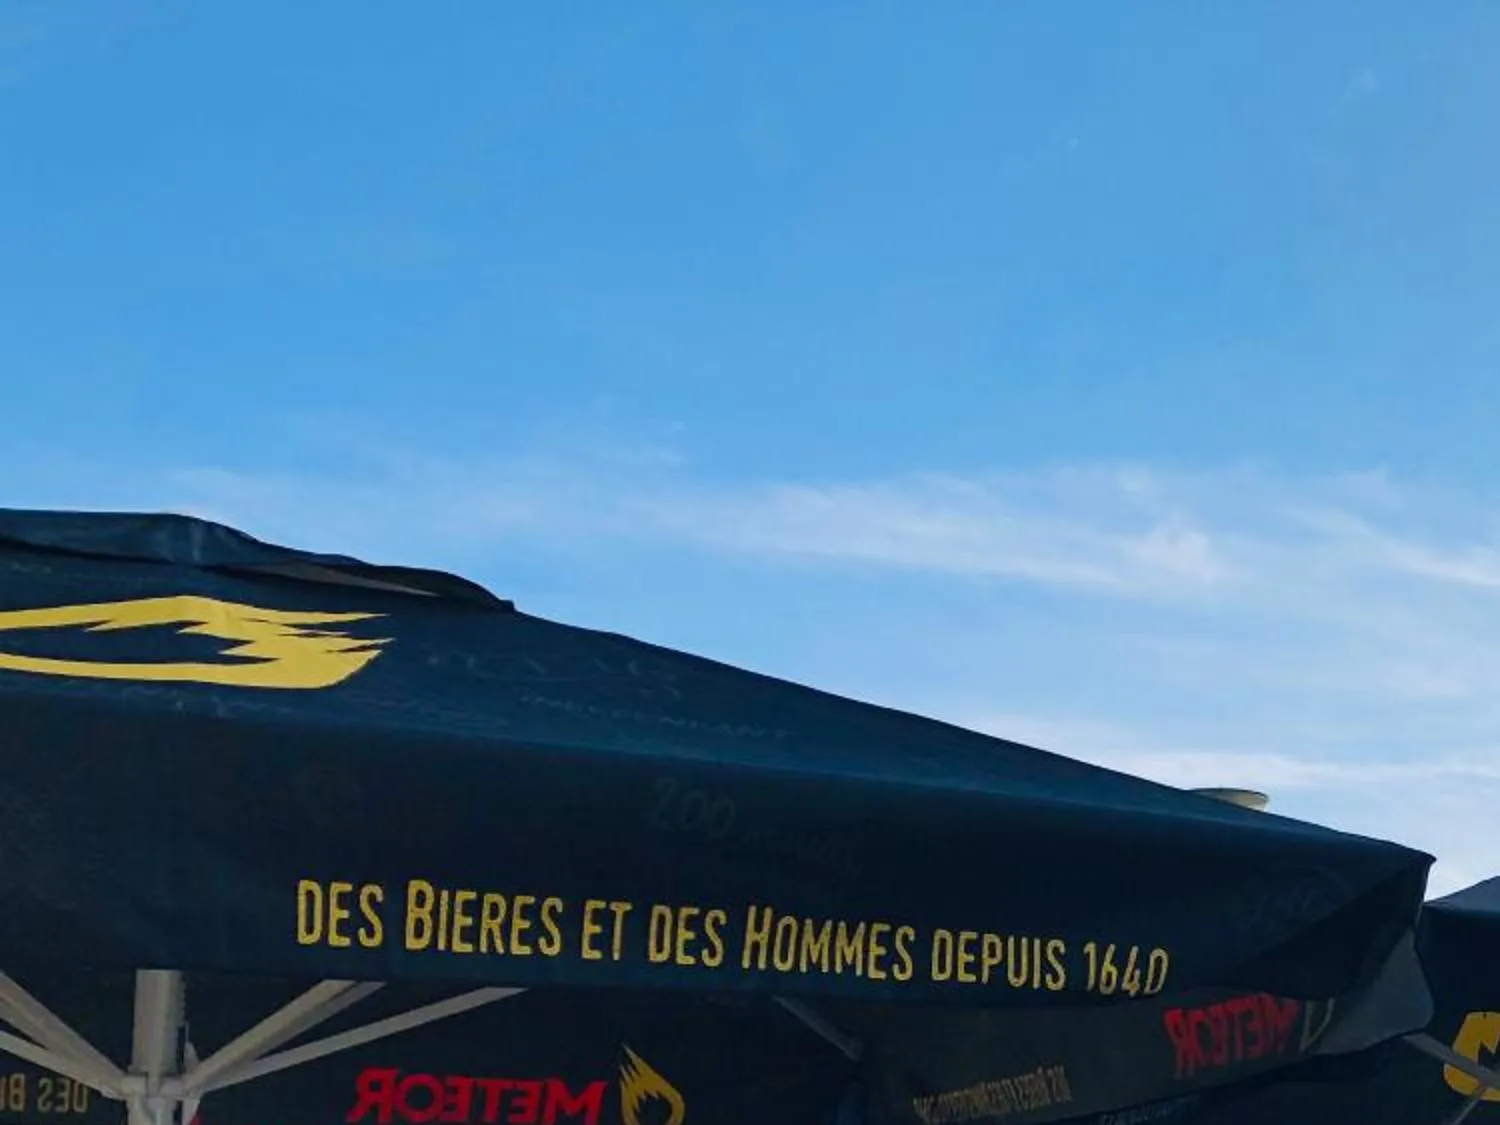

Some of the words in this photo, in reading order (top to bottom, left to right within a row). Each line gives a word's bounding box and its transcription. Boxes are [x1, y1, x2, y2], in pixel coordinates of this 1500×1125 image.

[297, 878, 384, 948] DES
[404, 879, 564, 957] BIERES
[581, 900, 633, 961] ET
[648, 904, 728, 968] DES
[741, 904, 916, 983] HOMMES
[931, 928, 1067, 992] DEPUIS
[1082, 941, 1170, 998] 1640
